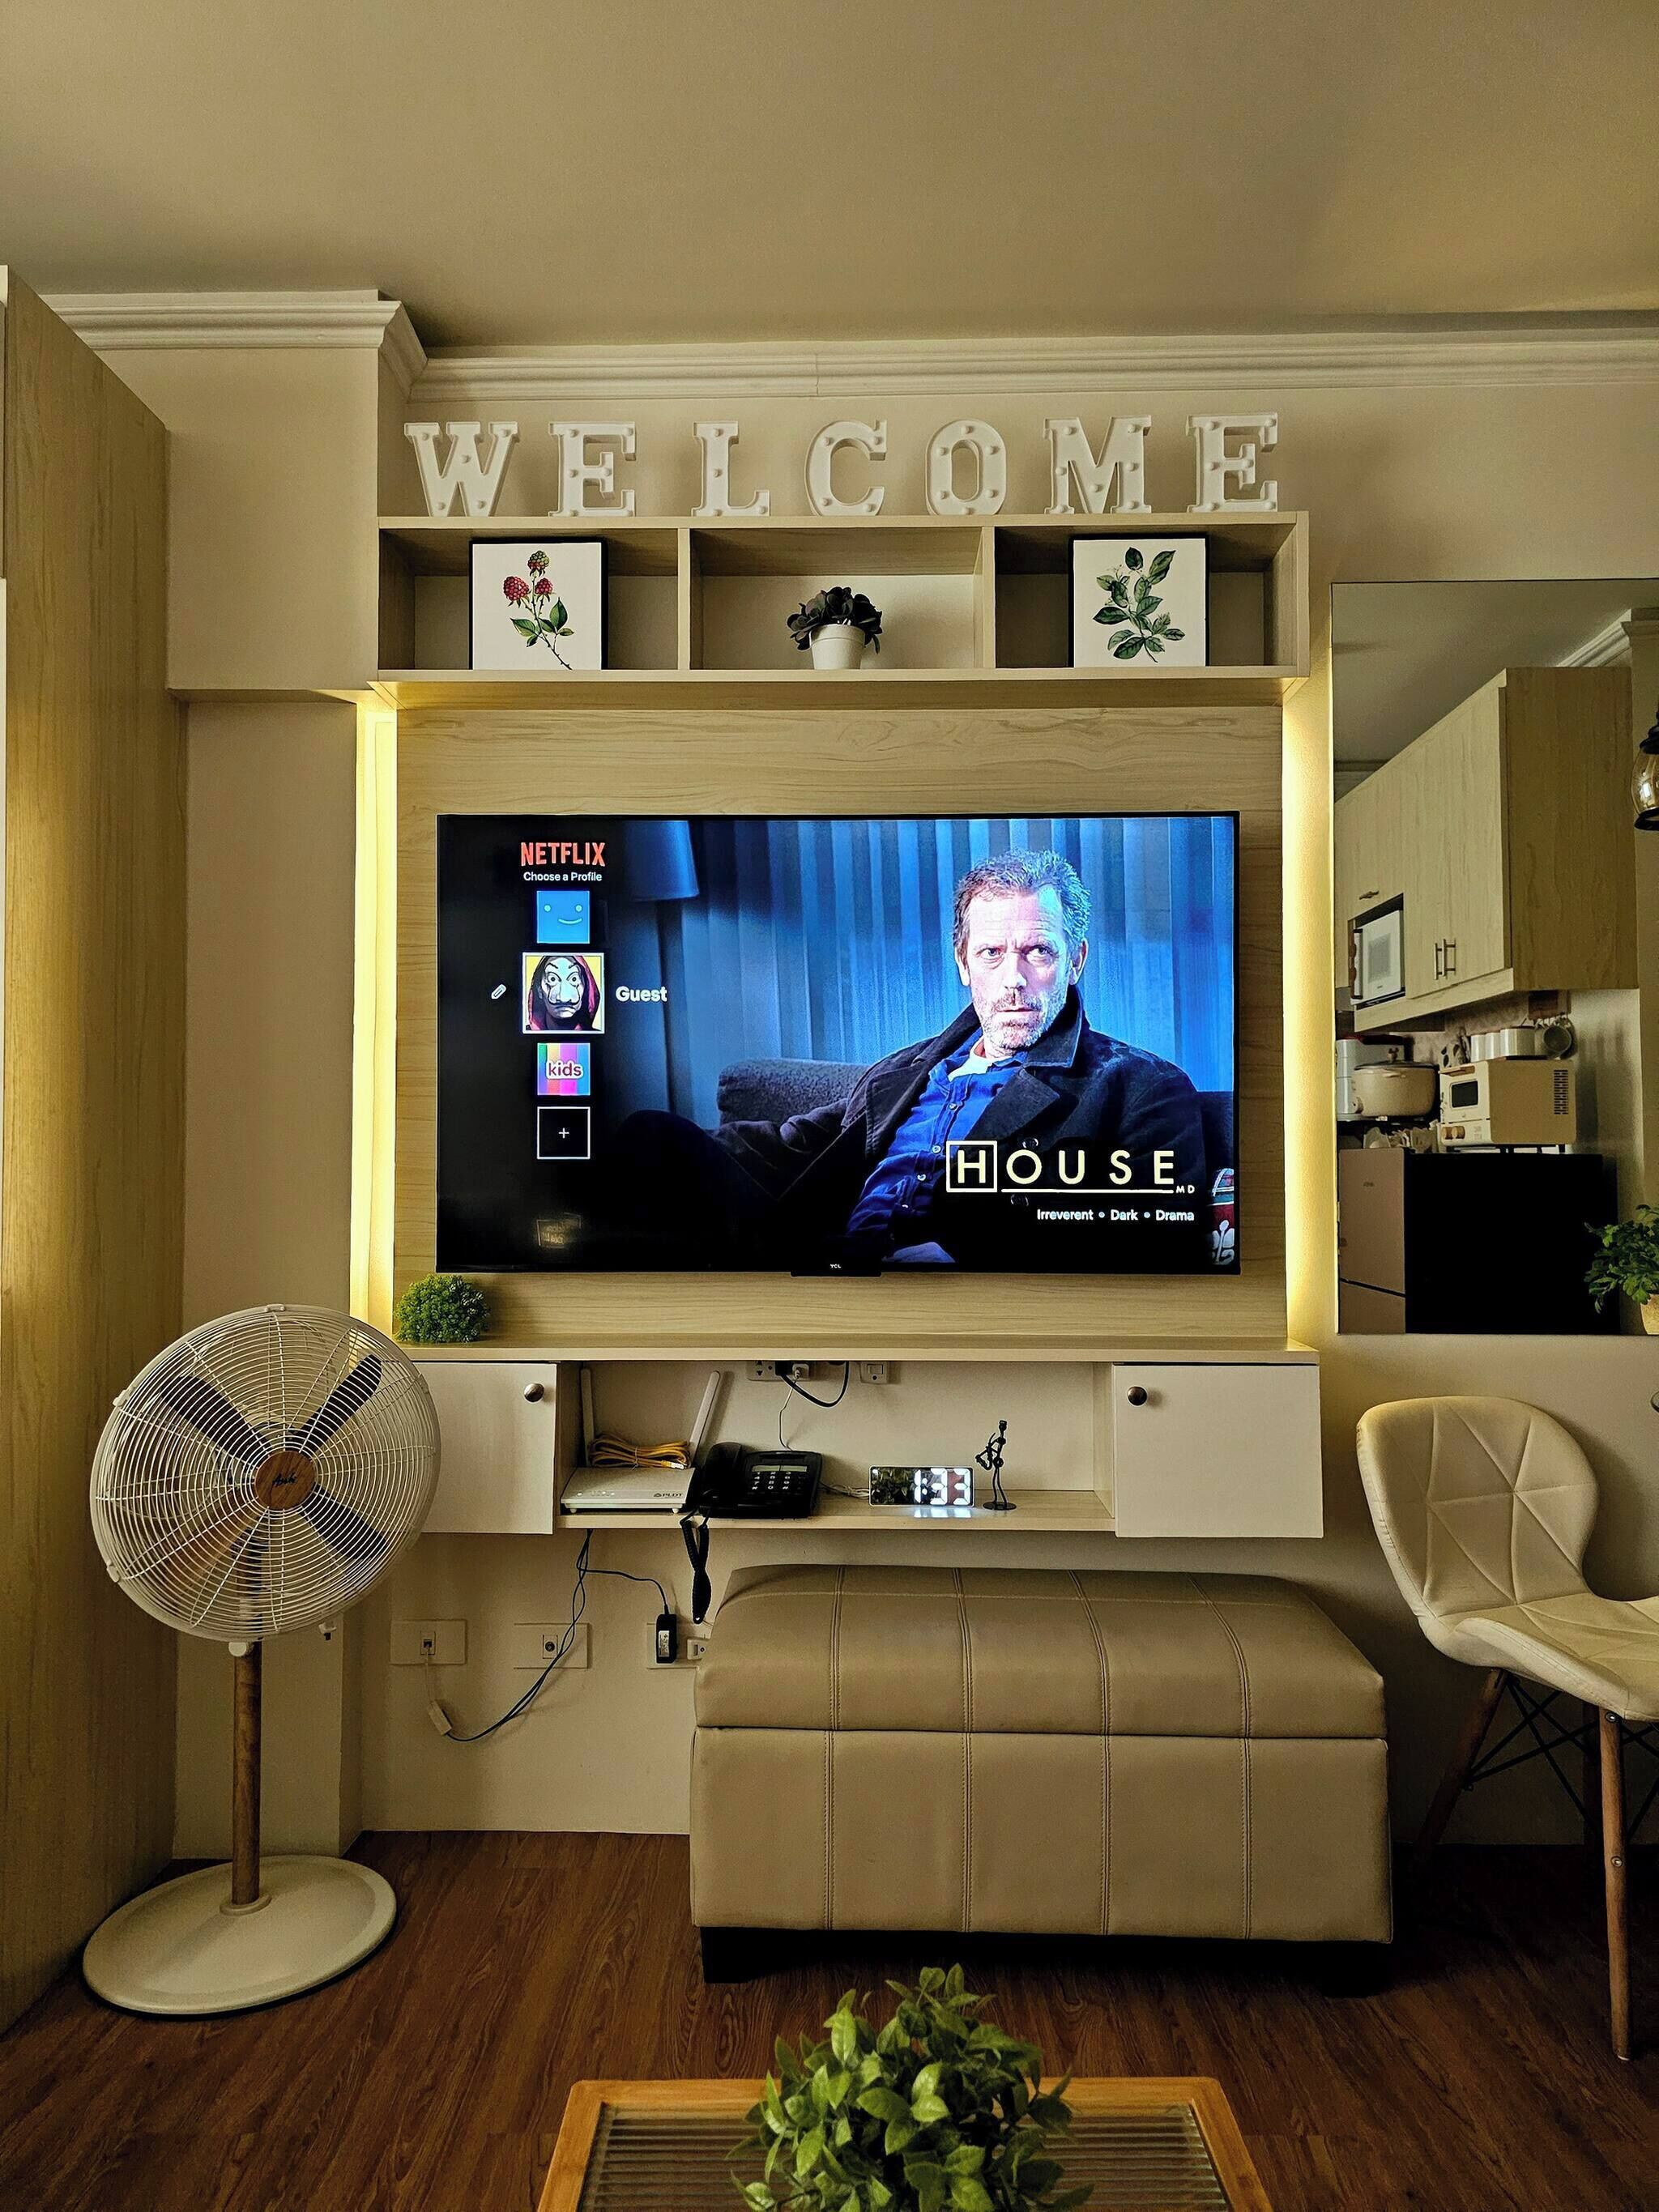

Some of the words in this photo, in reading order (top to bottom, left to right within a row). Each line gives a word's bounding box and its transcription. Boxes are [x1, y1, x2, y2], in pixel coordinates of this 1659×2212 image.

[404, 413, 1278, 517] WELCOME
[520, 842, 606, 867] NETFLIX
[522, 872, 561, 882] Choose
[570, 872, 603, 882] Profile
[616, 986, 667, 1002] Guest
[548, 1062, 582, 1076] kids
[956, 1149, 1175, 1186] HOUSE
[1037, 1208, 1094, 1221] Irreverent
[1110, 1208, 1138, 1221] Dark
[1155, 1209, 1195, 1221] Drama
[913, 1467, 971, 1506] 1:33
